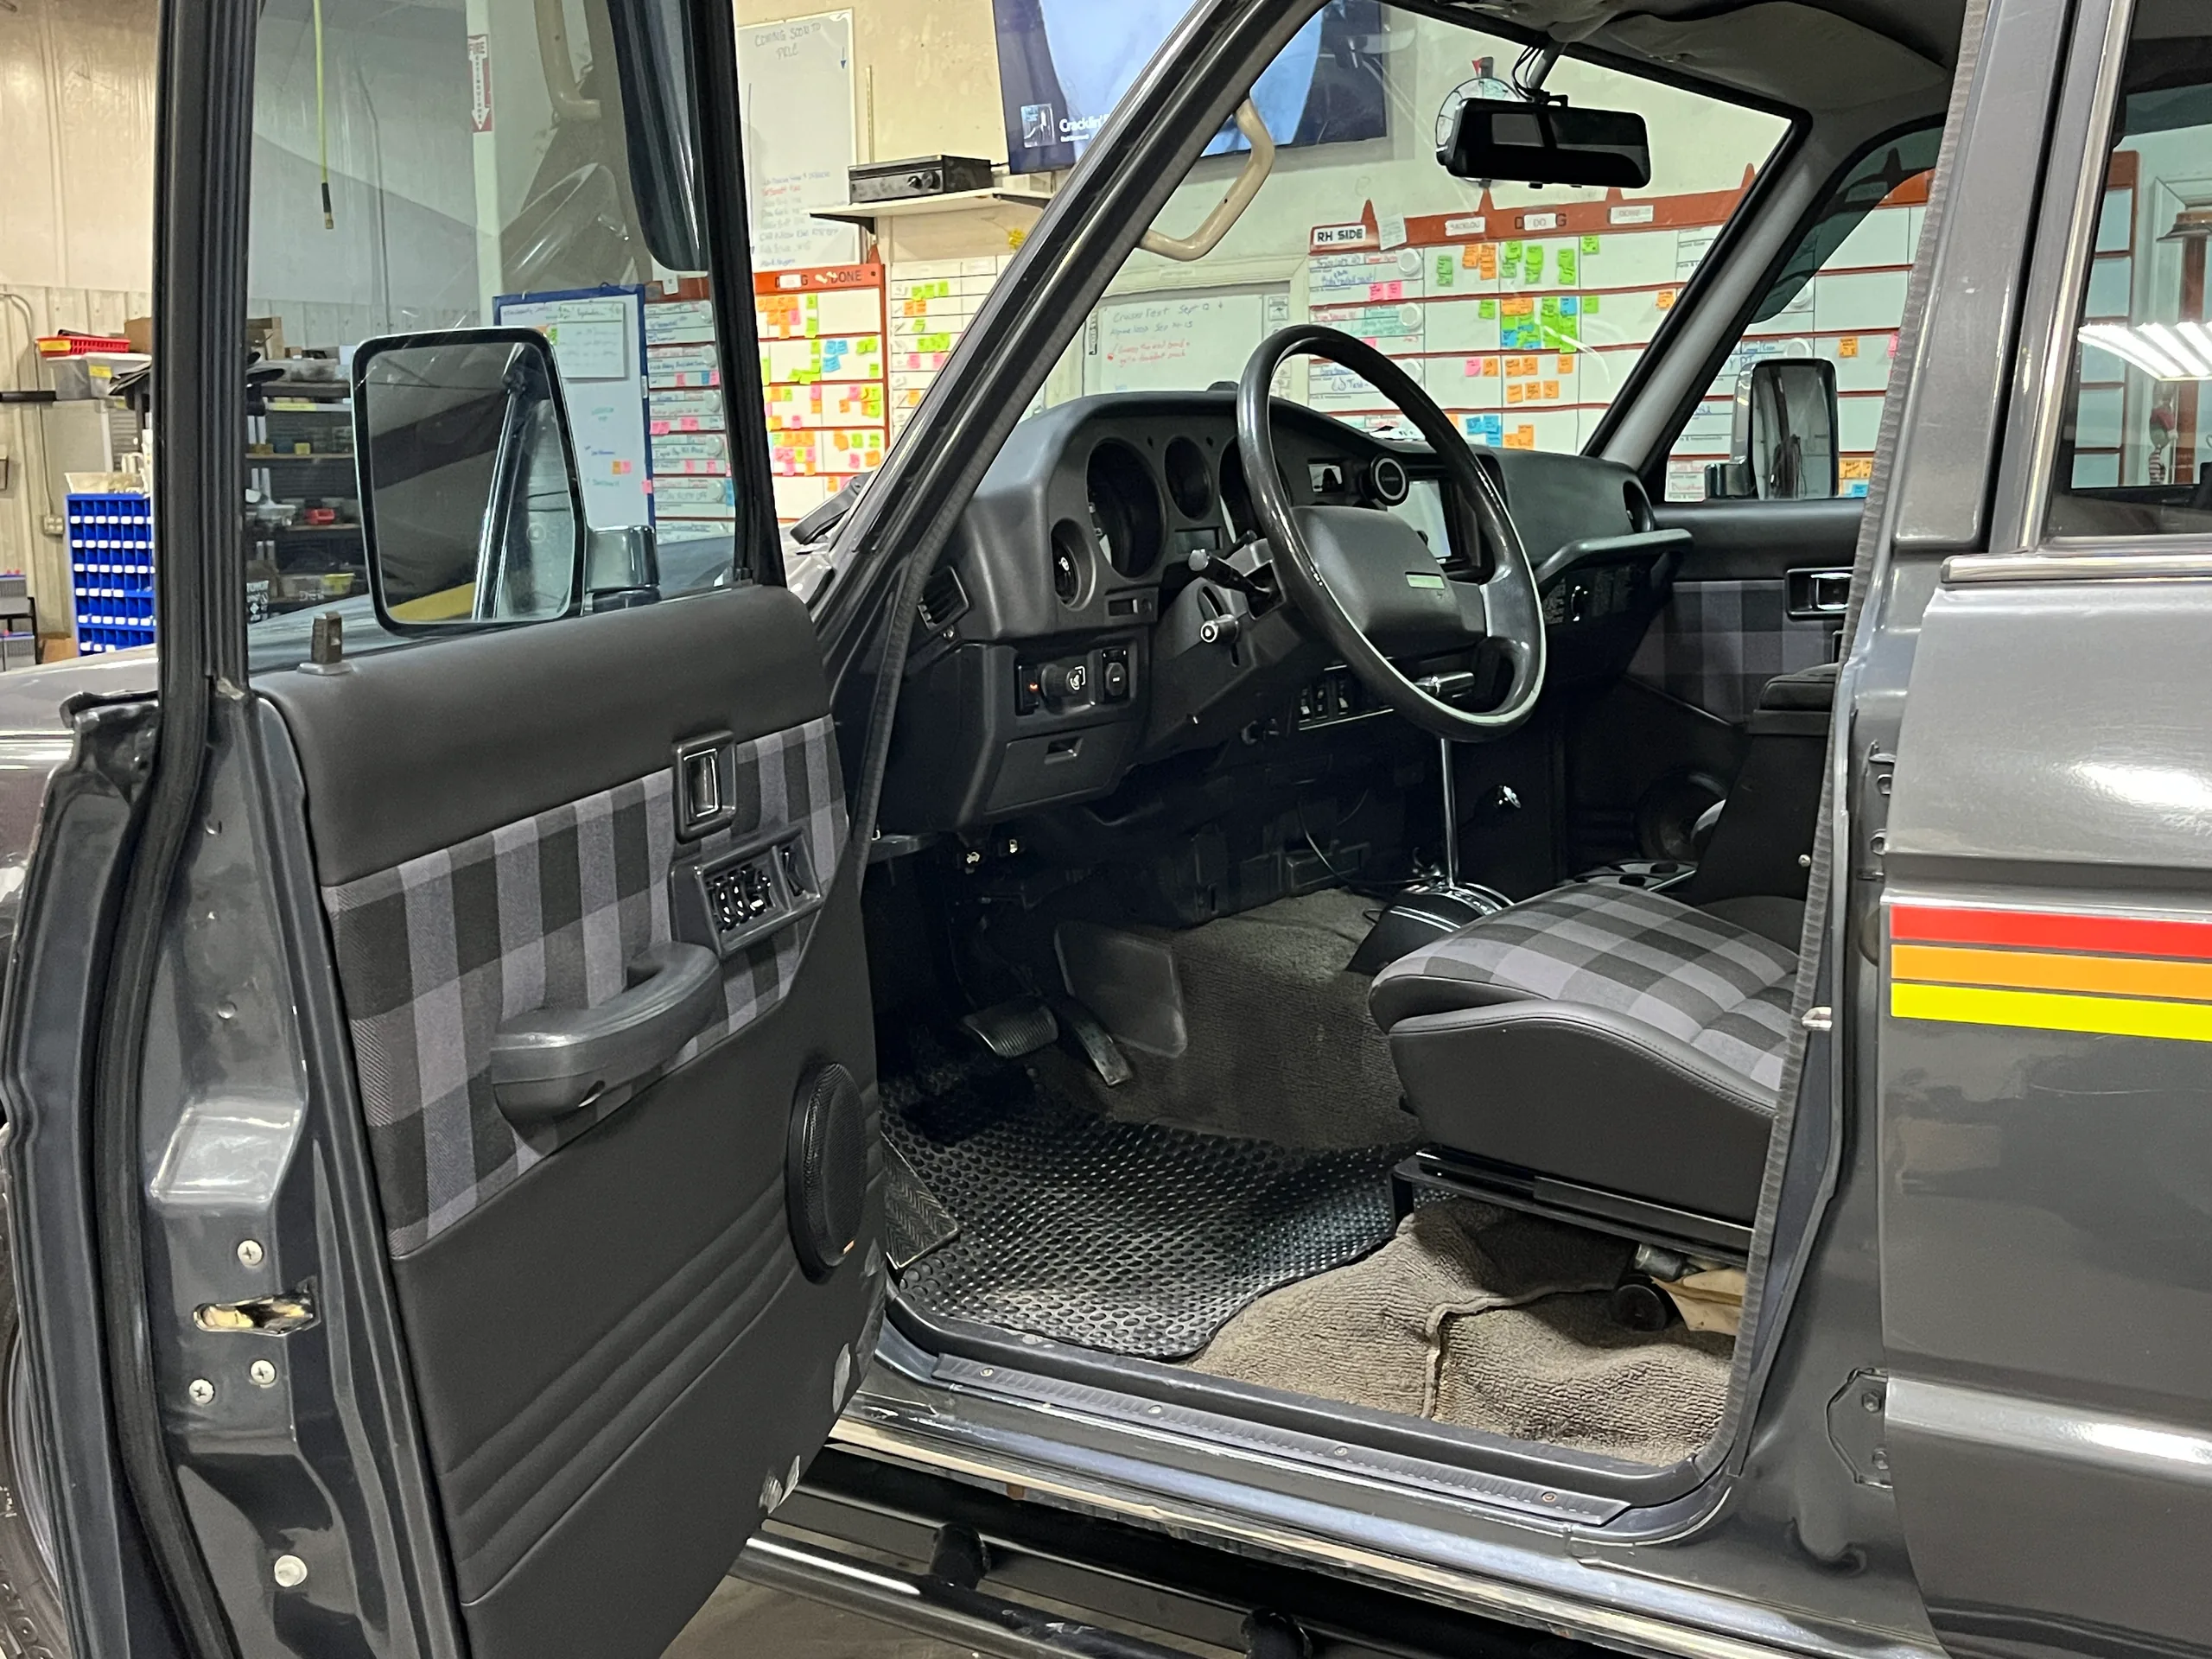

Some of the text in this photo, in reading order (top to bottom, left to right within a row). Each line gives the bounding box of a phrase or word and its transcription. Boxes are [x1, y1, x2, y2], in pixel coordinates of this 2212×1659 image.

[1317, 228, 1363, 242] RH SIDE
[831, 270, 861, 284] DONE
